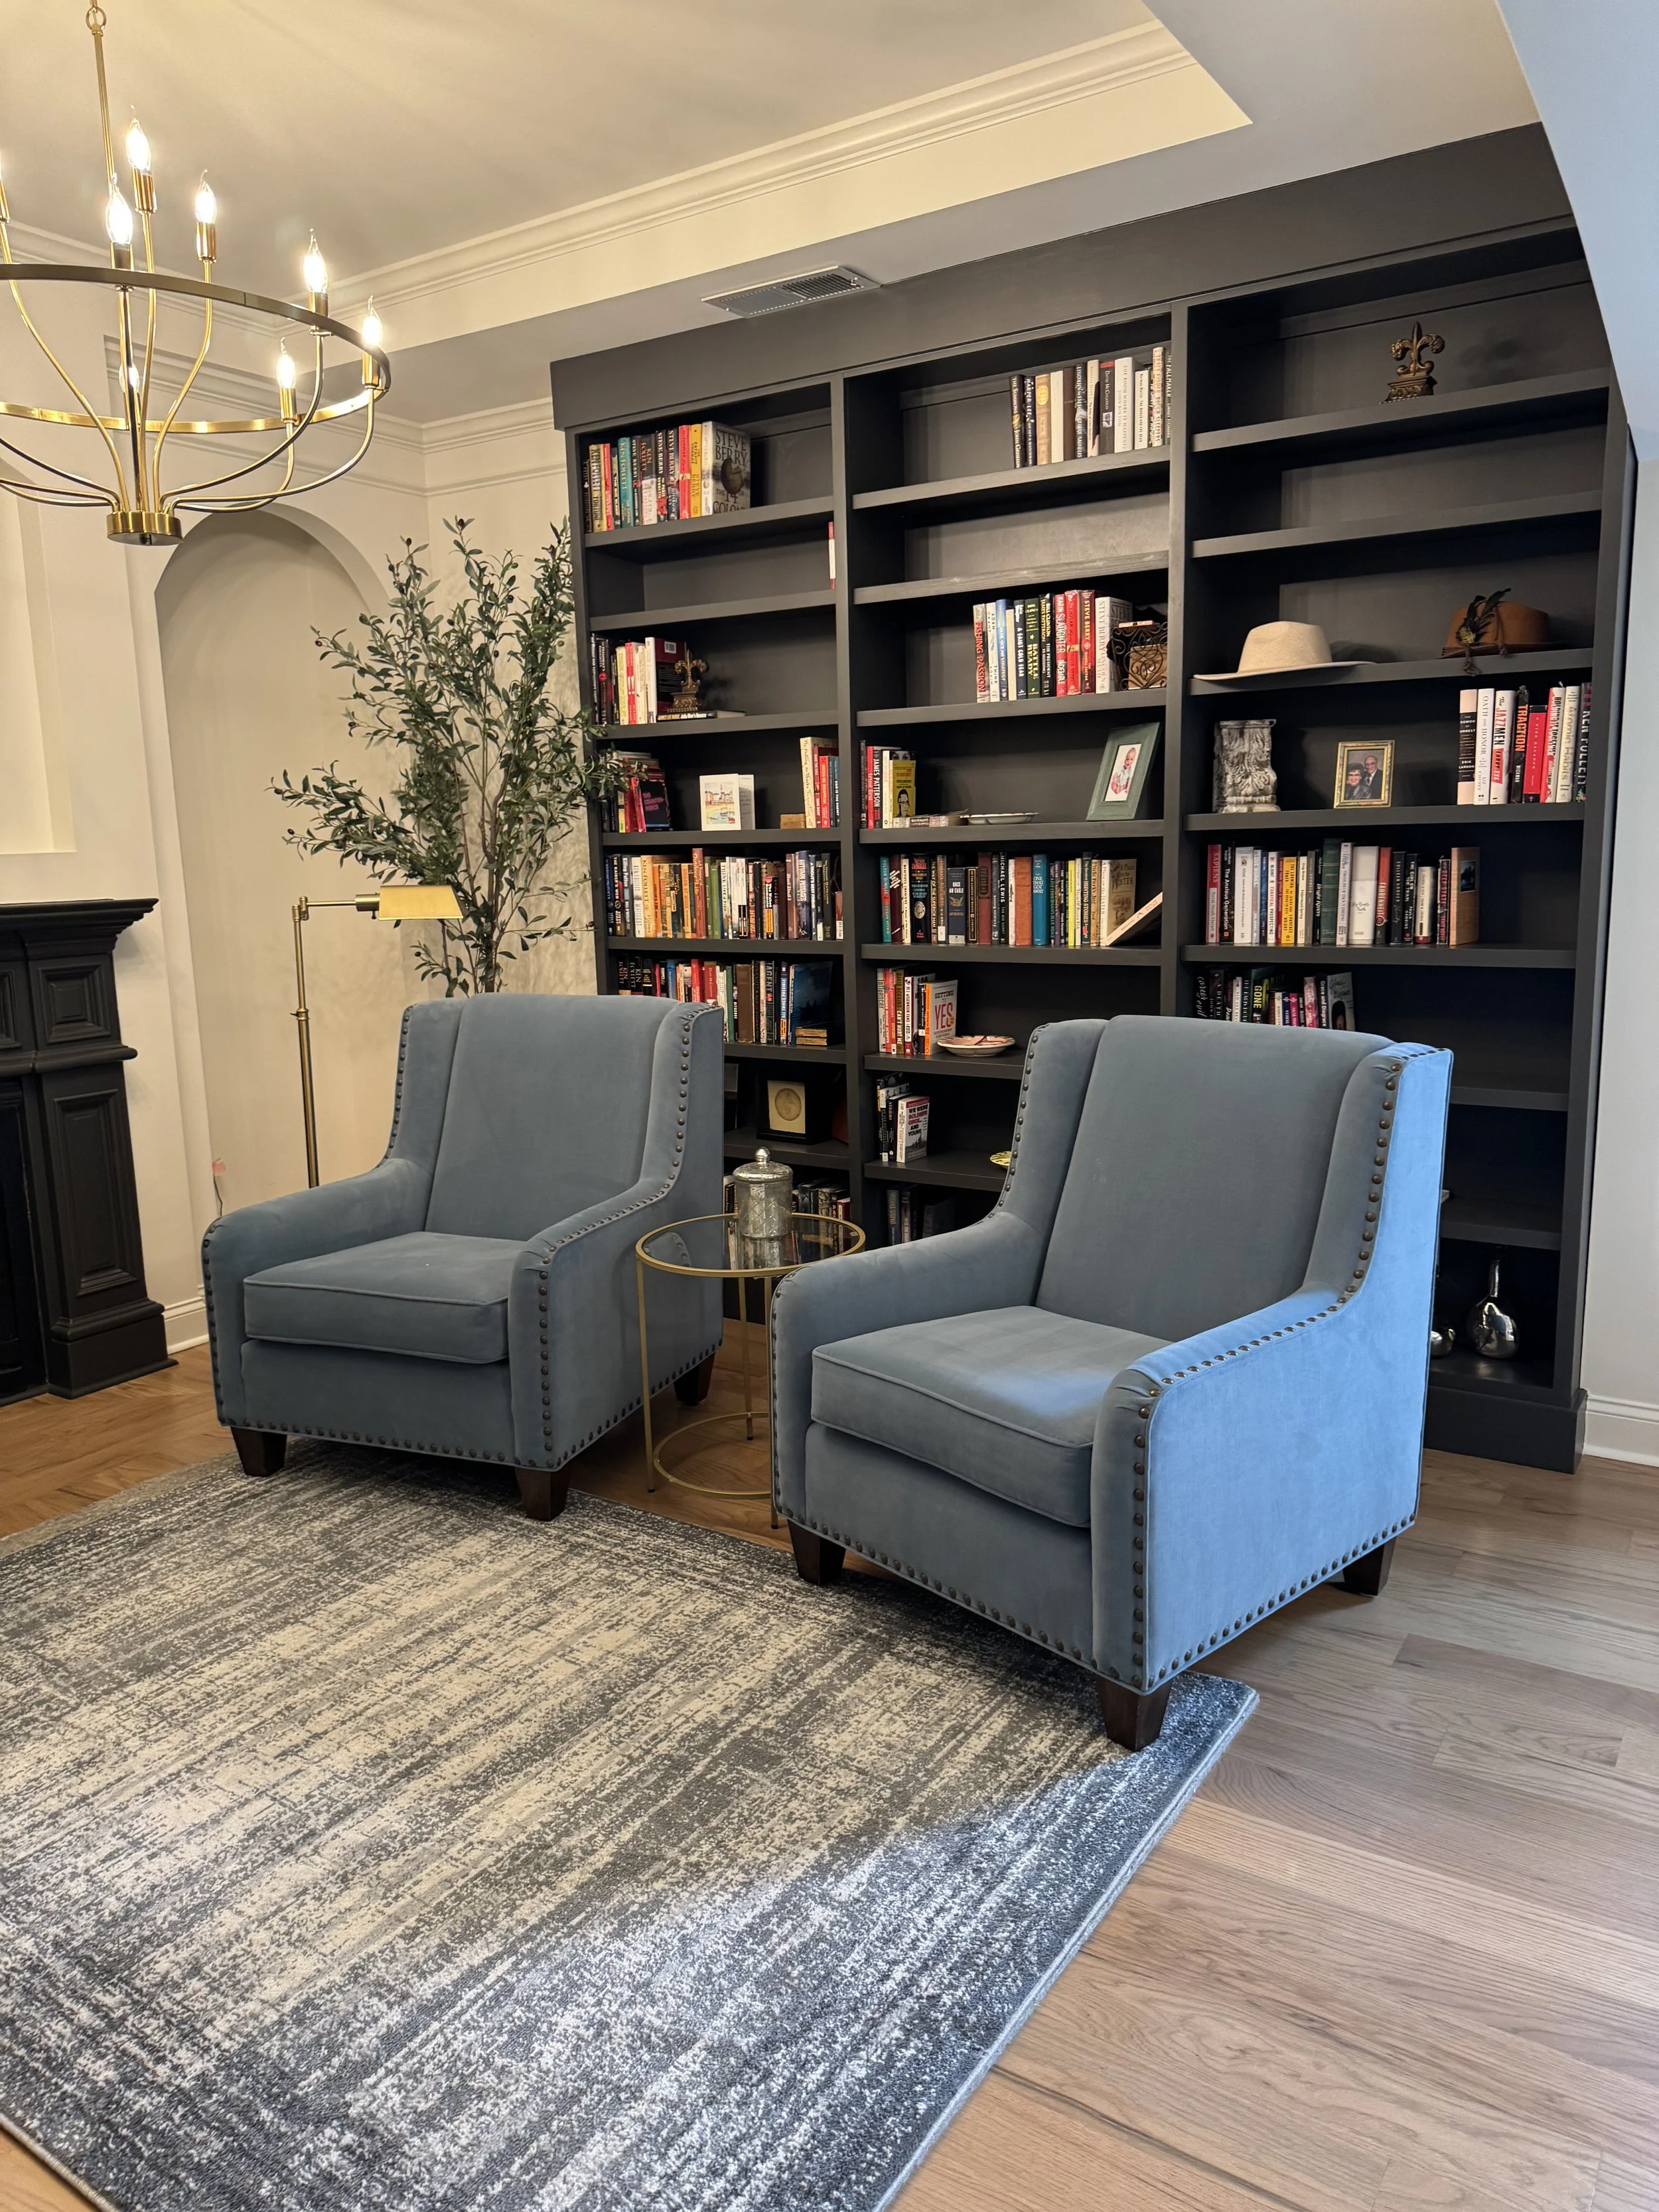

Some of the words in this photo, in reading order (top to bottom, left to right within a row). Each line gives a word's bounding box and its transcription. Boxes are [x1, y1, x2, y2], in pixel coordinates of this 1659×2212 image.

[1025, 379, 1034, 402] HARPER
[716, 429, 747, 451] STEVE
[591, 449, 600, 463] KEN
[716, 445, 747, 467] BERRY
[1056, 614, 1066, 653] SLAUGHTER
[1550, 698, 1561, 721] HOLDING
[1515, 704, 1528, 752] TRACTION
[1565, 706, 1576, 743] Atomic
[1548, 729, 1558, 755] TOGETHER
[1562, 747, 1575, 780] Habits
[1376, 883, 1386, 915] FAHRENHEIT
[1254, 986, 1262, 1008] GONE
[935, 1002, 954, 1029] YES
